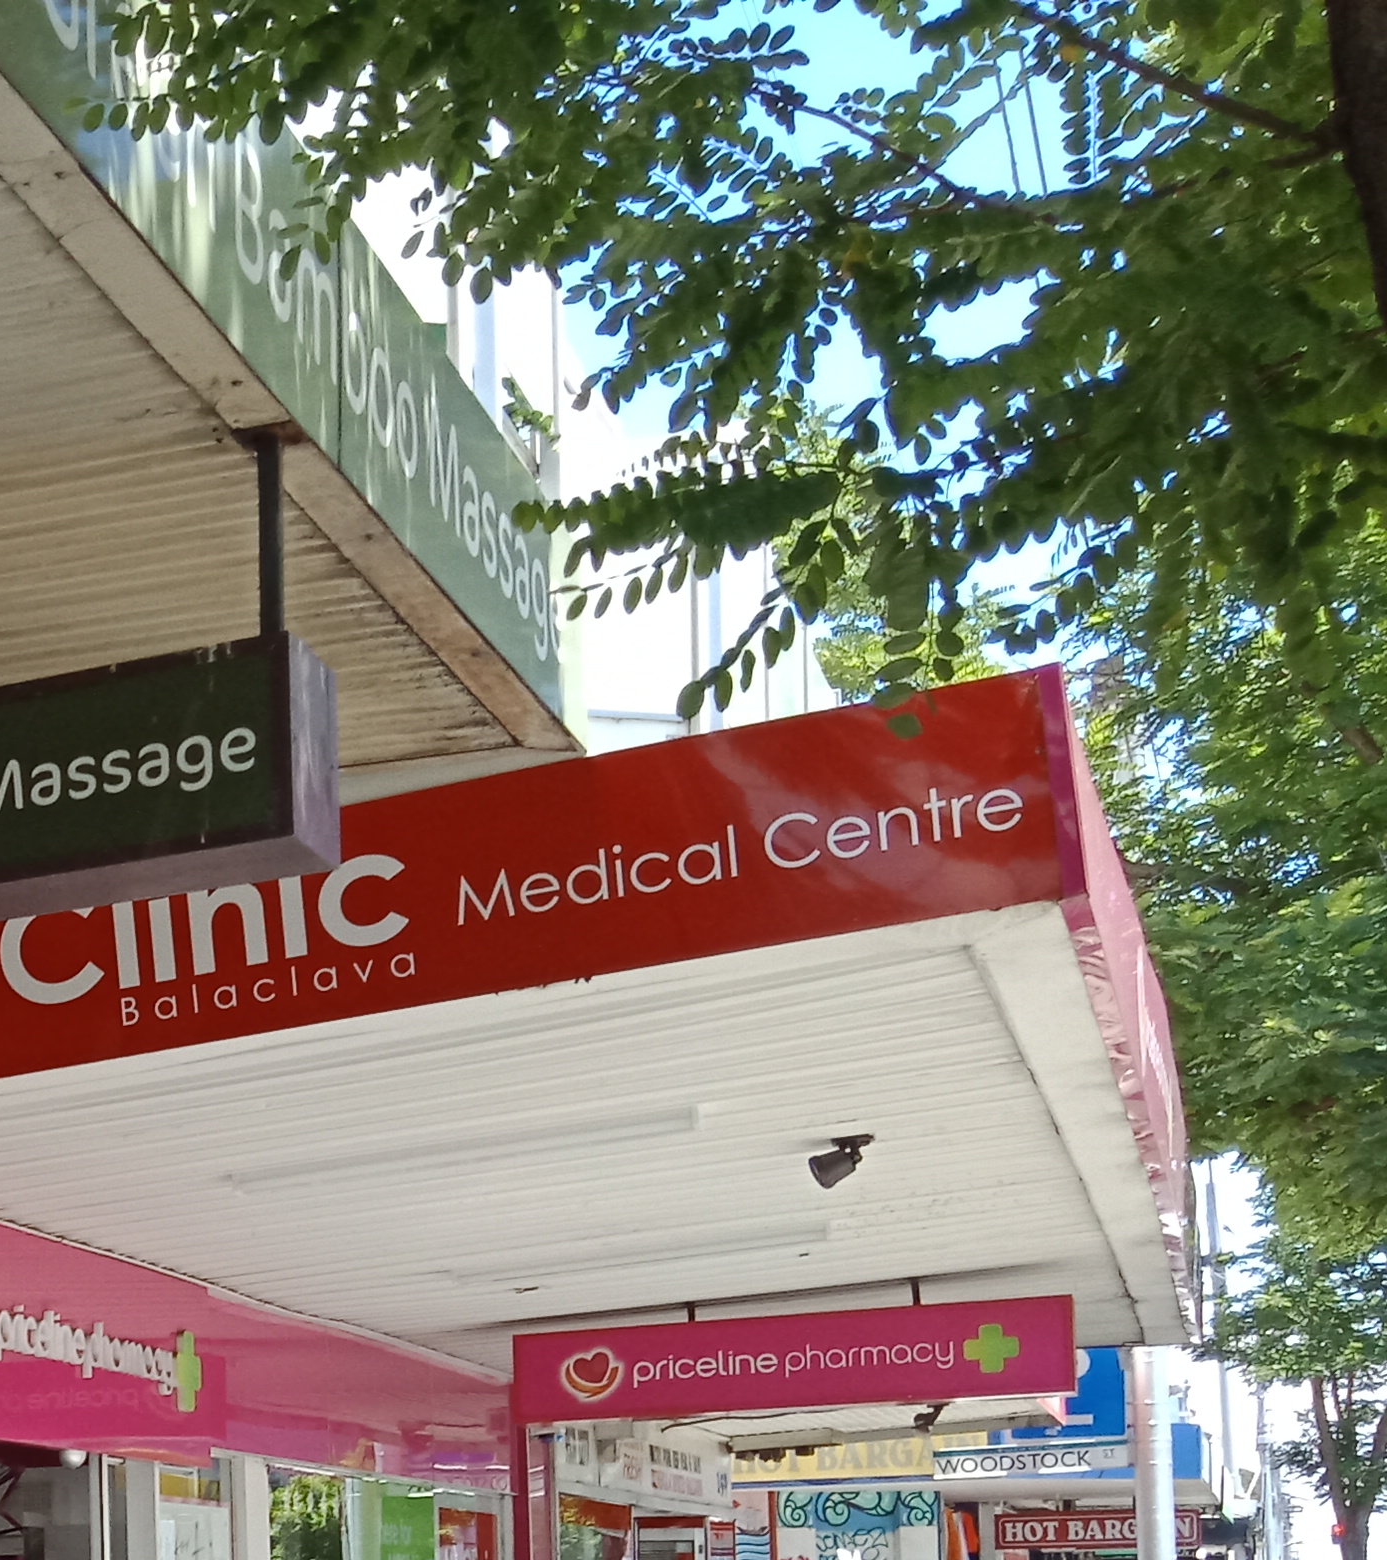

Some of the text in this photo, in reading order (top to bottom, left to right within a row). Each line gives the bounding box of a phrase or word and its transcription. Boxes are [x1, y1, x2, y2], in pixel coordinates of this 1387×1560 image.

[457, 825, 739, 926] Medical
[763, 786, 1024, 871] Centre
[119, 947, 418, 1027] Balaclava
[632, 1341, 955, 1388] priceline pharmacy
[936, 1450, 1092, 1475] WOODSTOCK
[1004, 1517, 1192, 1542] HOT BARGN
